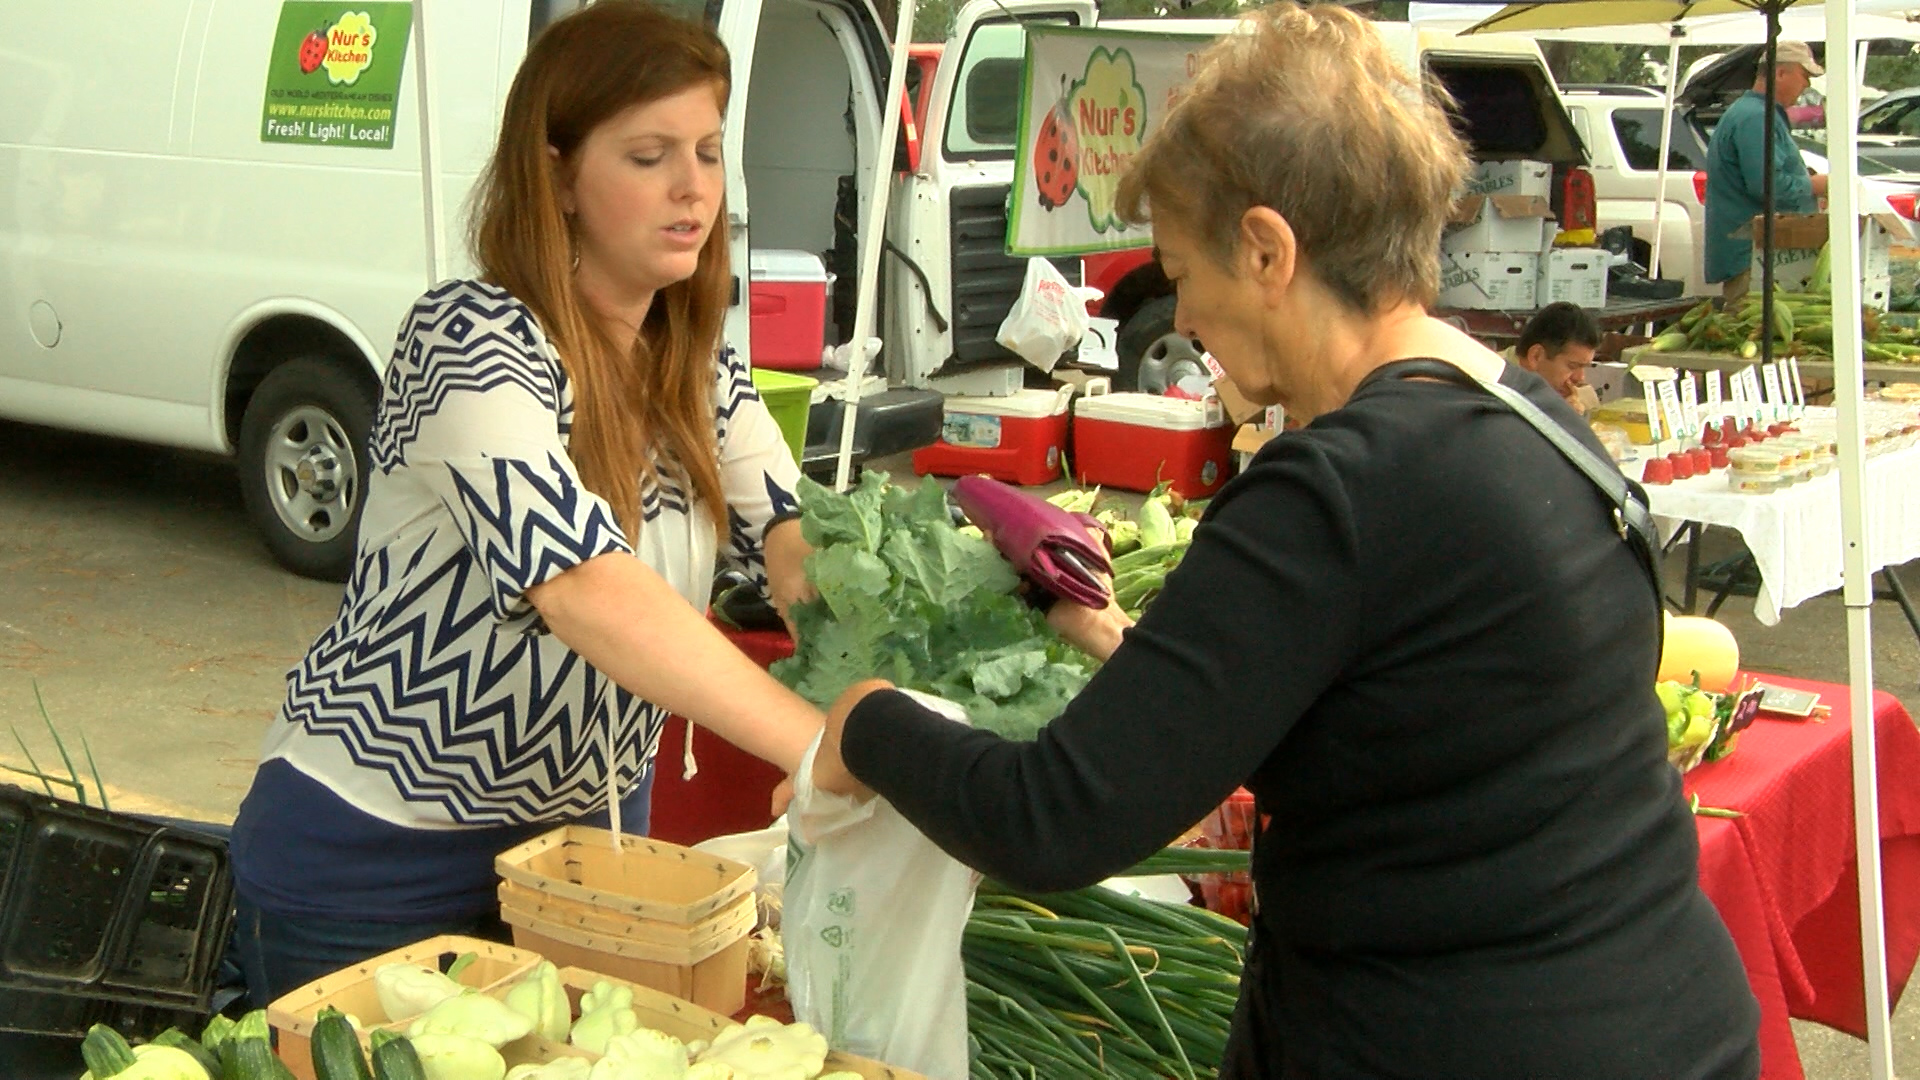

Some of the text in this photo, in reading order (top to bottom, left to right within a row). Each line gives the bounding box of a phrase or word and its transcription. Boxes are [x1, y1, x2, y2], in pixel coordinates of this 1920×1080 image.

[331, 28, 371, 47] Nur's
[326, 49, 368, 64] Kitchen
[268, 102, 392, 120] www.nurskitchen.com
[1078, 96, 1136, 136] Nur's
[267, 119, 389, 142] Fresh! Light! Local!
